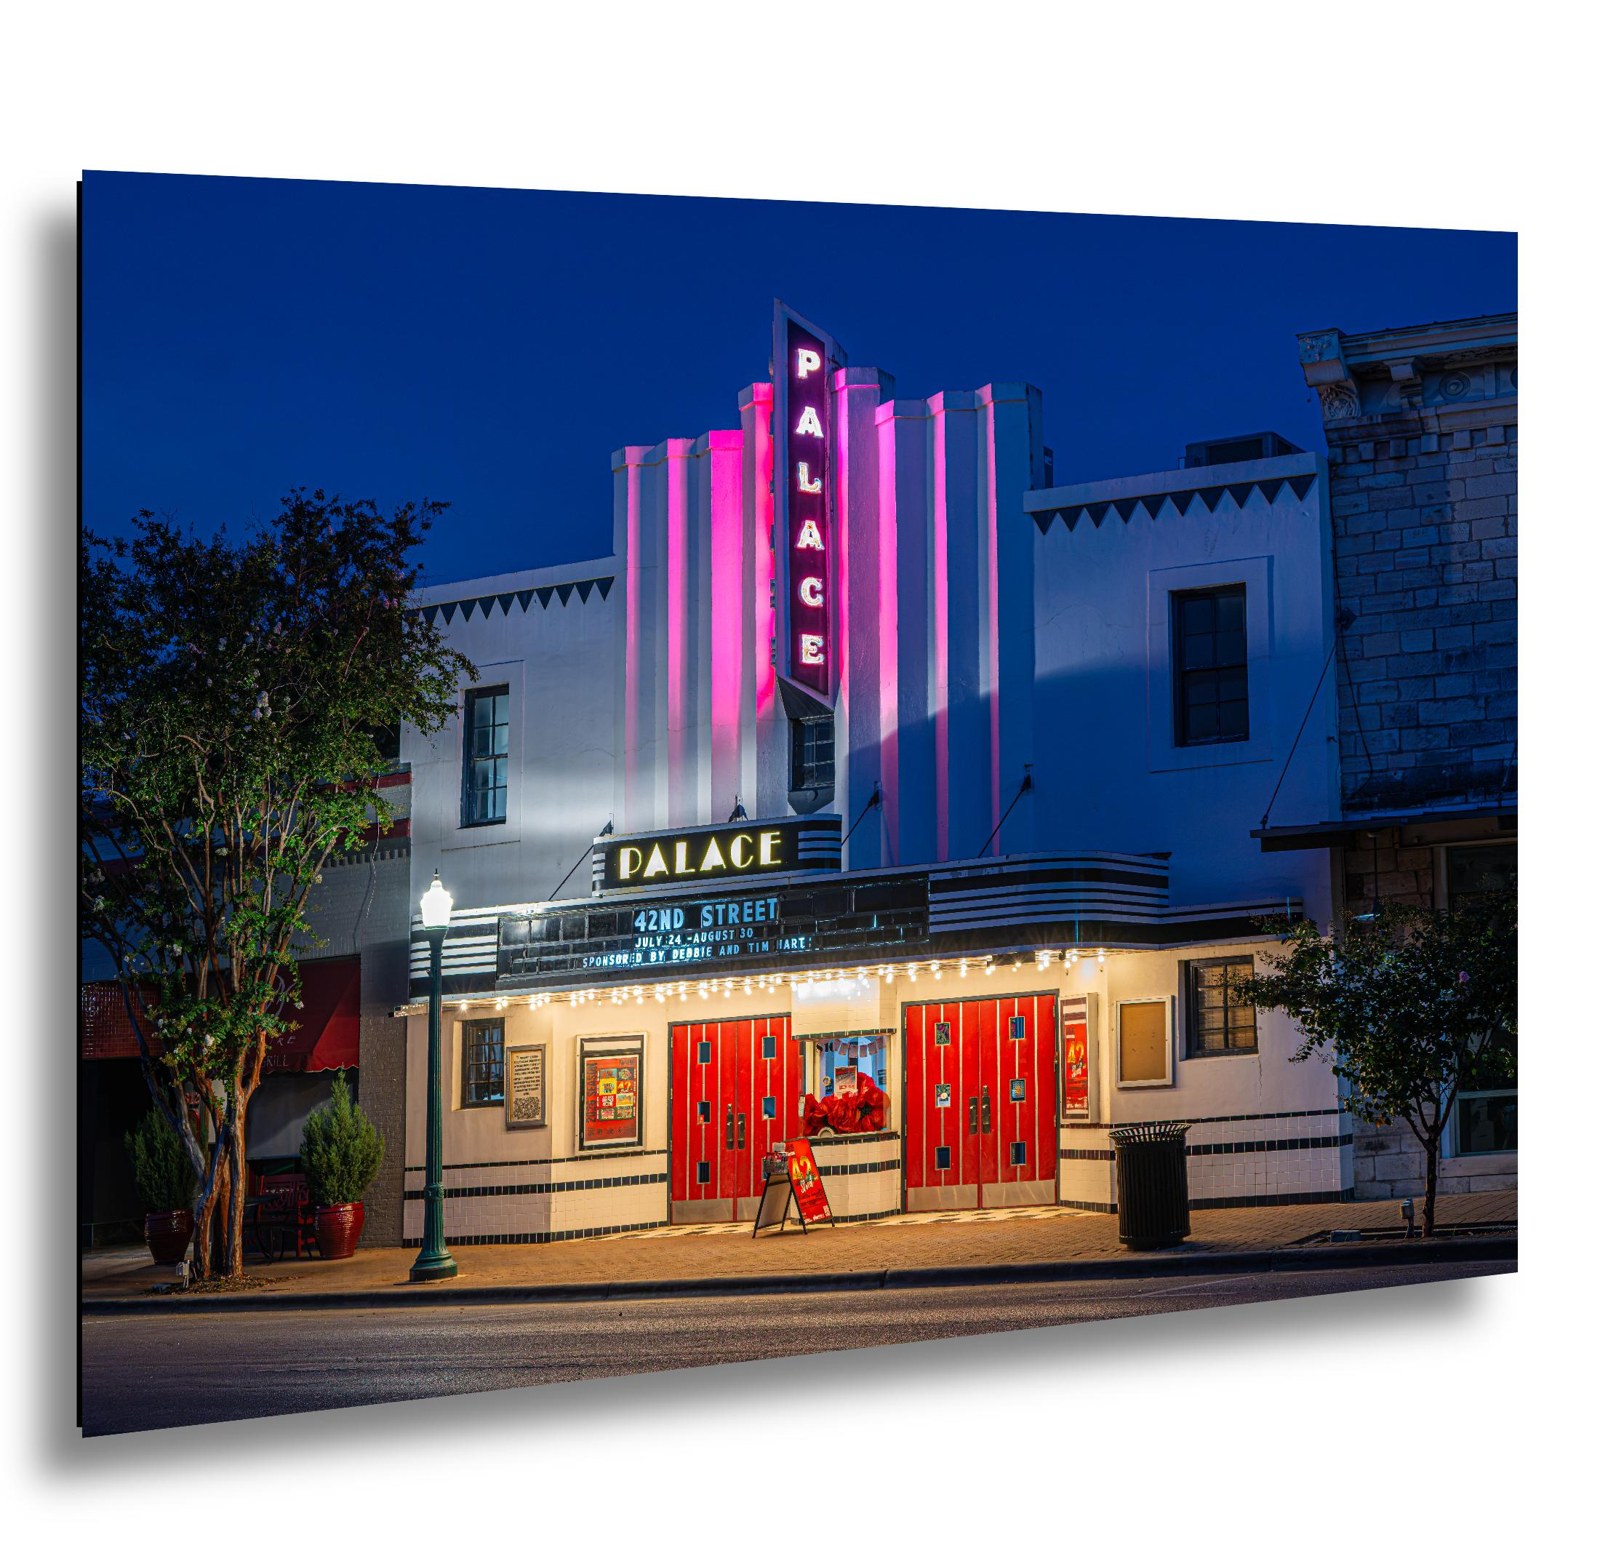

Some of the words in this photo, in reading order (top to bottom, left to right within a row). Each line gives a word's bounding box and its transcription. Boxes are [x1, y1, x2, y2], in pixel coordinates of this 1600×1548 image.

[796, 347, 825, 666] PALACE
[618, 831, 782, 880] PALACE
[634, 908, 684, 932] 42ND
[701, 898, 778, 927] STREET
[582, 951, 642, 968] SPONSORED
[650, 950, 665, 962] BY
[672, 946, 712, 960] DEBBIE
[719, 944, 740, 956] AND
[749, 940, 769, 953] TIM
[635, 936, 662, 948] JULY
[668, 934, 681, 945] 24
[740, 927, 753, 938] 30
